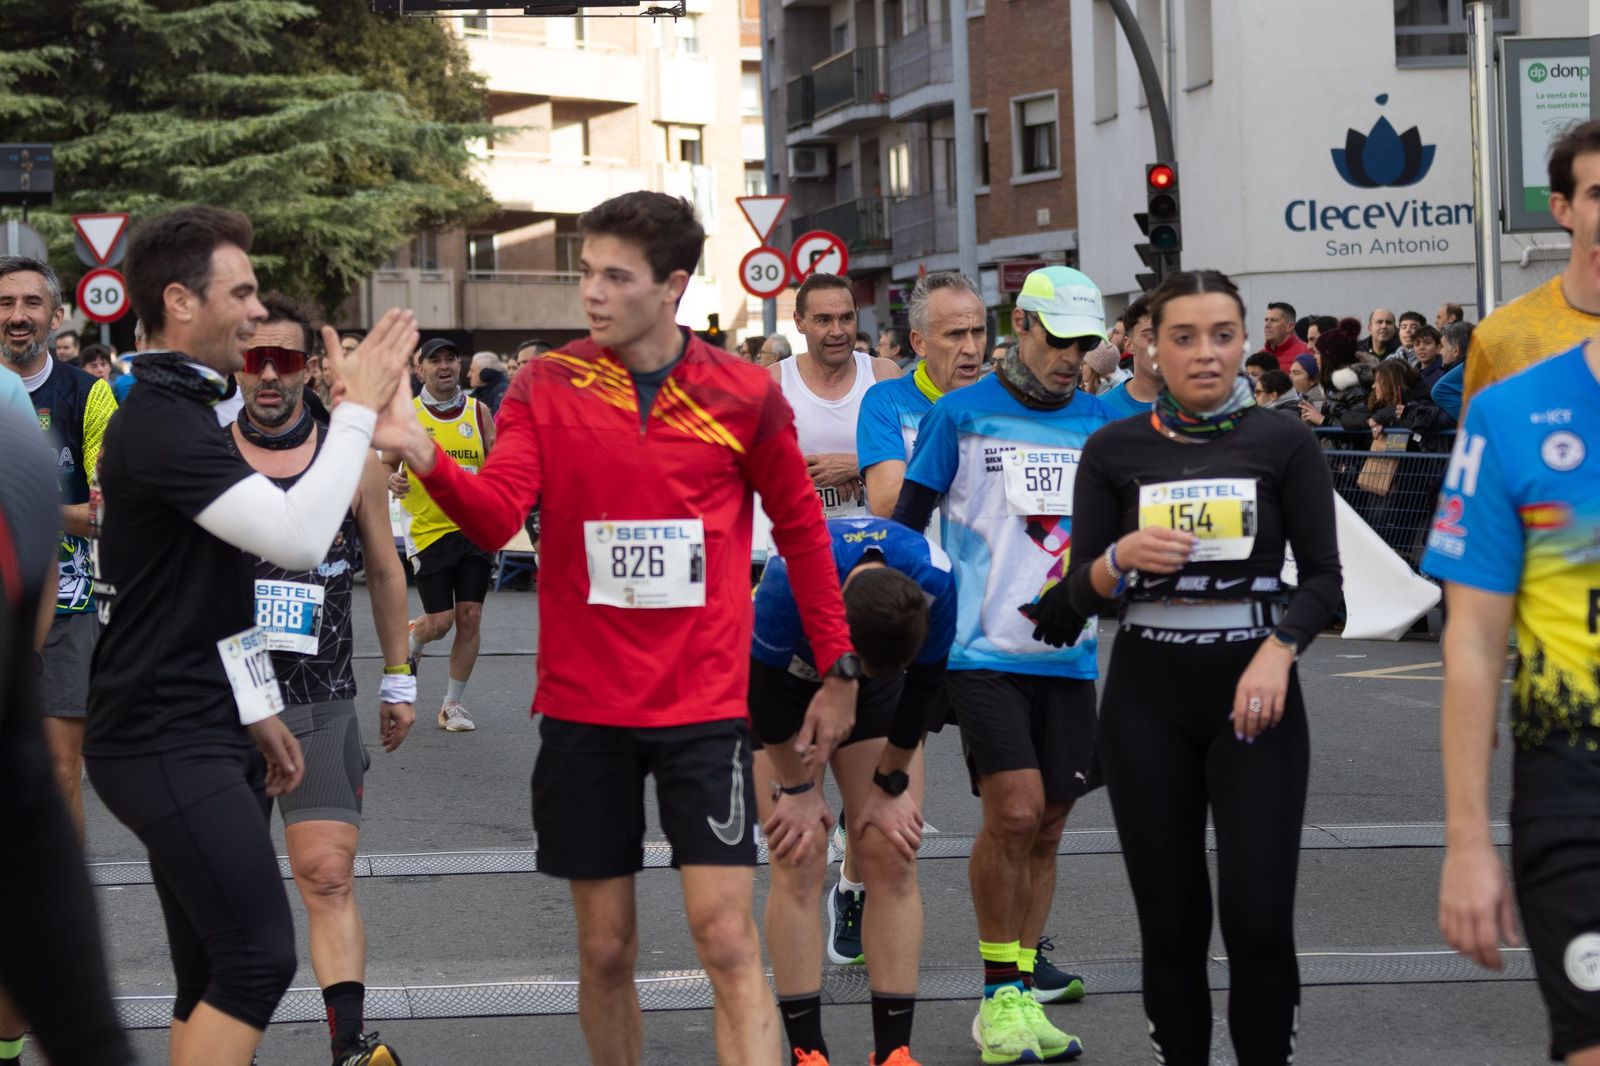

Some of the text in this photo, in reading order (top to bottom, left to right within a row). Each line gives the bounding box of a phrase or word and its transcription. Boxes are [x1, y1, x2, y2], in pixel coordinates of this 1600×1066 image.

[1529, 64, 1590, 81] dp donp
[1569, 91, 1578, 99] de
[1579, 91, 1588, 99] tu
[1547, 102, 1579, 110] nuestras
[1325, 236, 1449, 257] San Antonio
[750, 264, 779, 282] 30
[89, 287, 119, 305] 30
[445, 449, 479, 460] ORUELA
[985, 456, 1002, 464] SILV
[1027, 453, 1080, 464] SETEL
[1025, 467, 1063, 492] 587
[1170, 485, 1243, 499] SETEL
[1169, 502, 1214, 533] 154
[616, 526, 690, 540] SETEL
[611, 546, 665, 578] 826
[1175, 575, 1211, 591] NIKE
[255, 584, 317, 600] SETEL
[256, 599, 304, 629] 868
